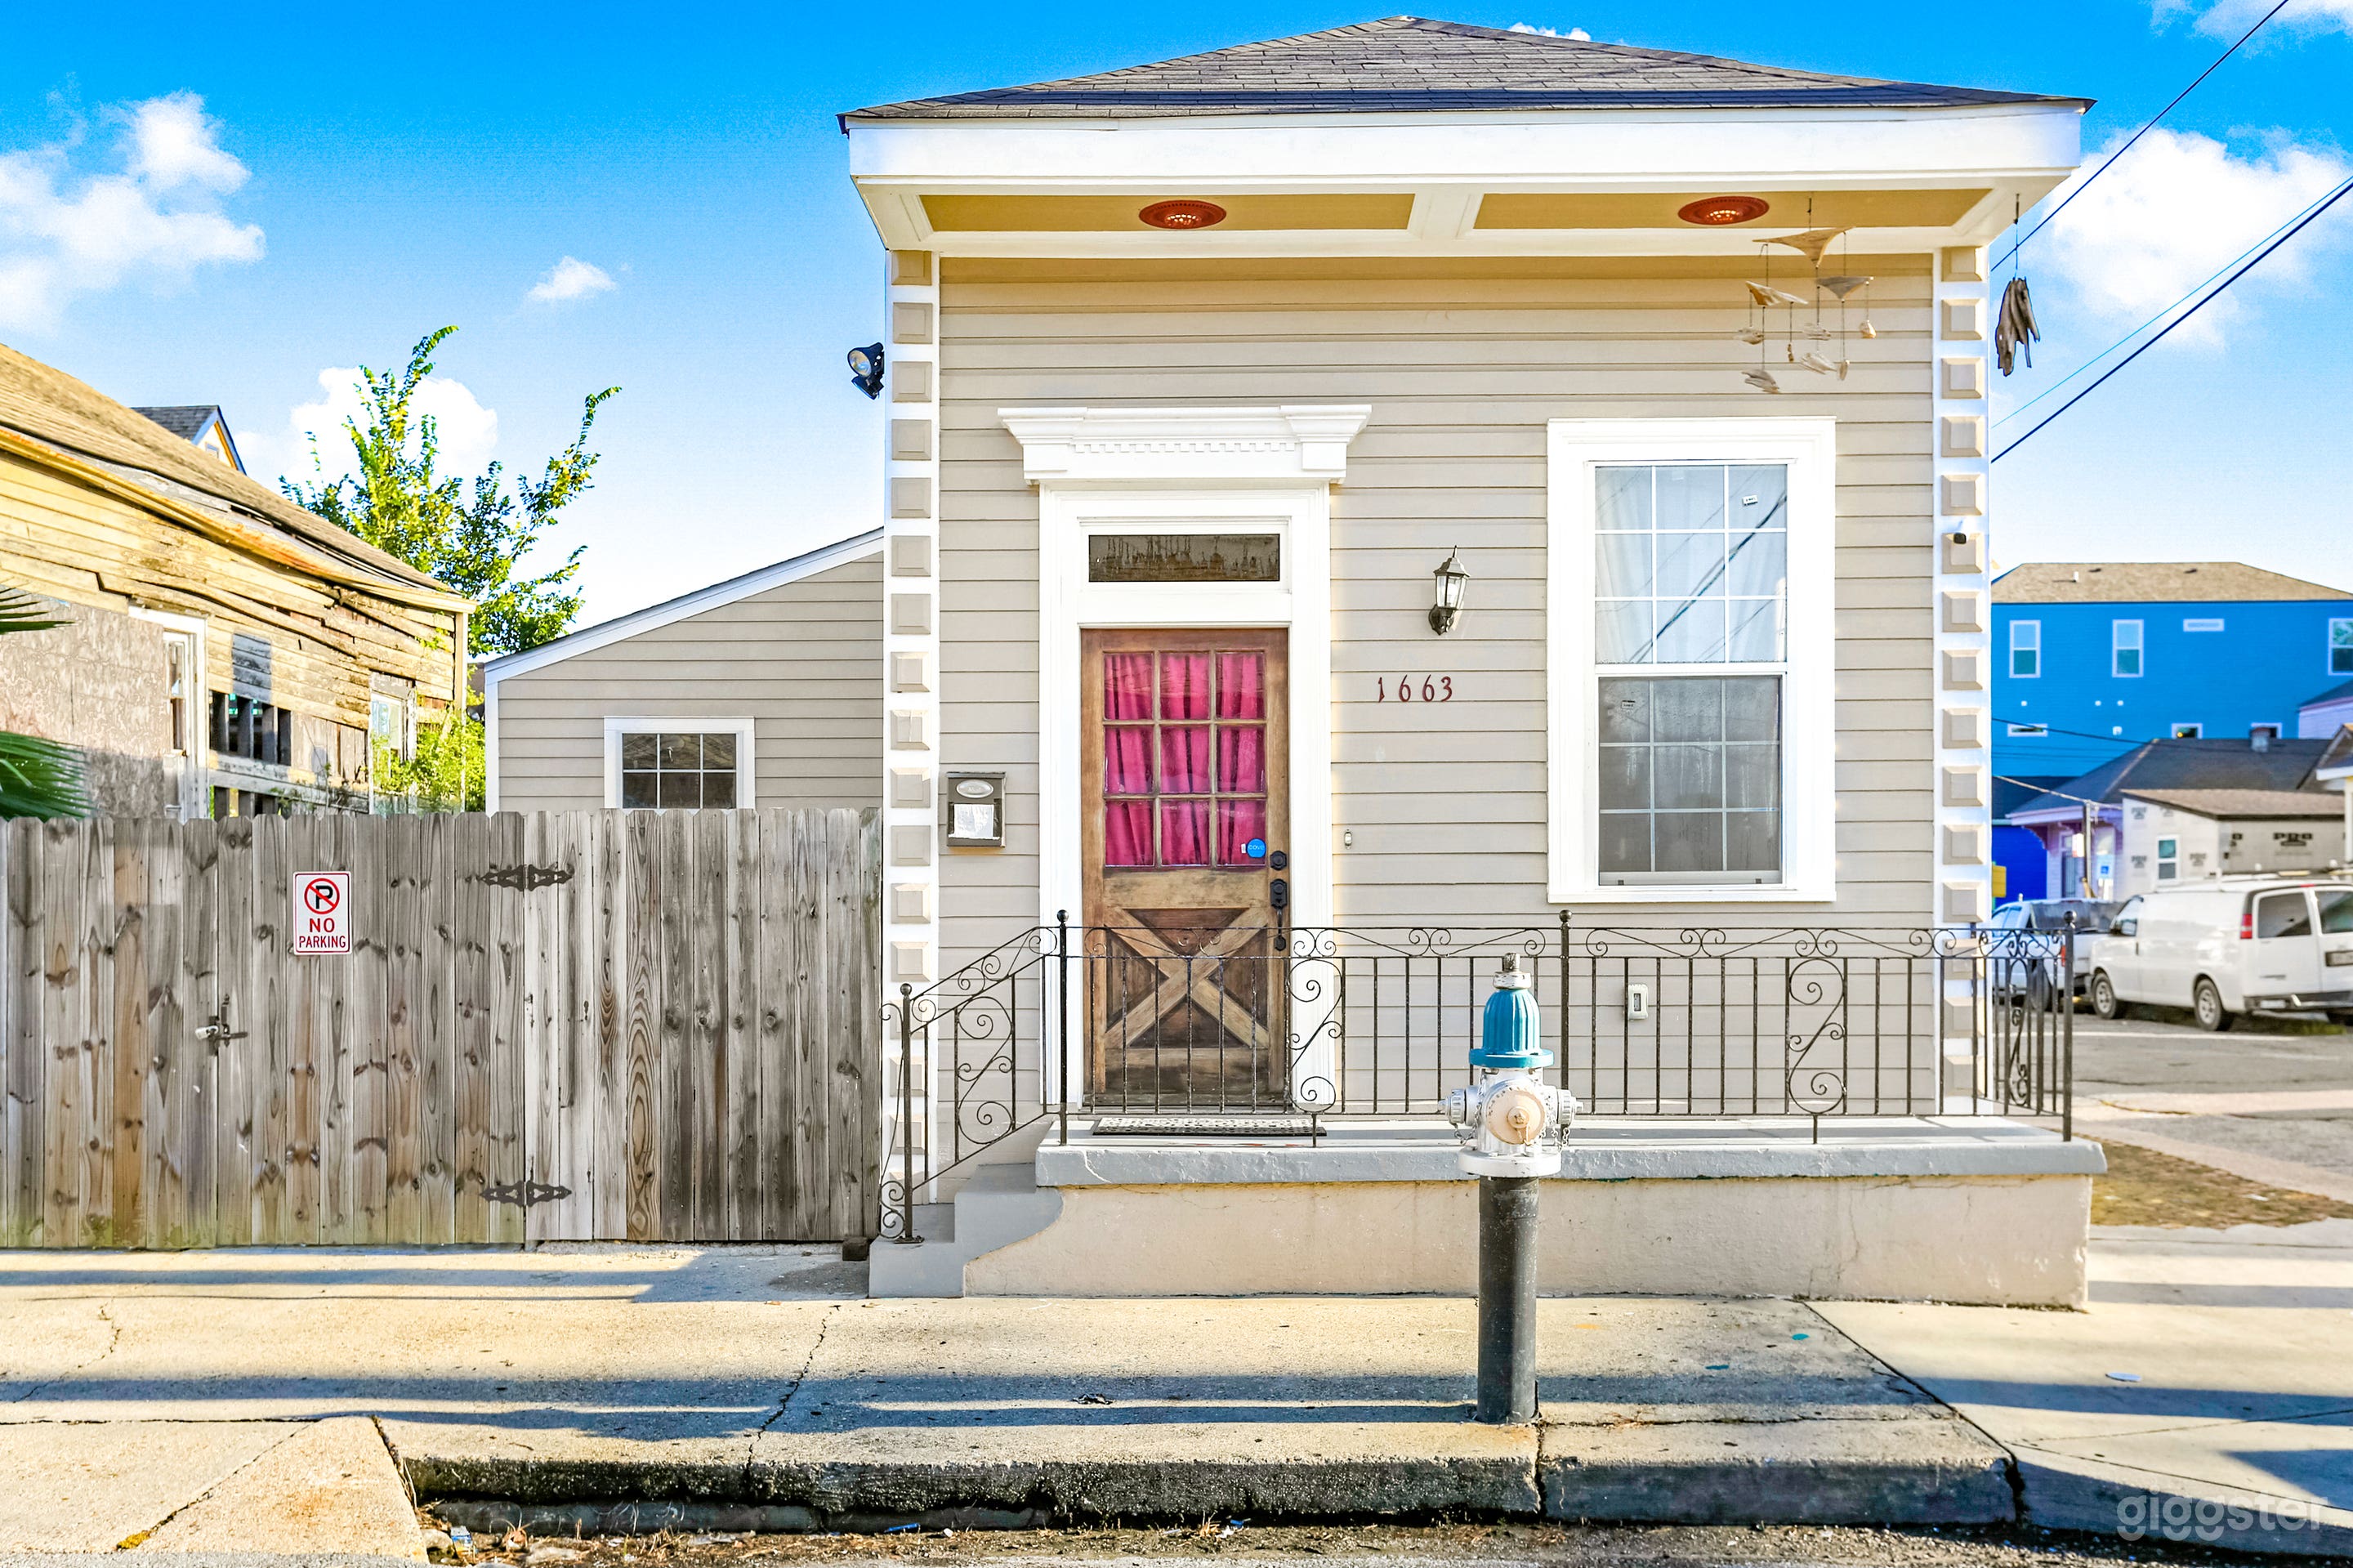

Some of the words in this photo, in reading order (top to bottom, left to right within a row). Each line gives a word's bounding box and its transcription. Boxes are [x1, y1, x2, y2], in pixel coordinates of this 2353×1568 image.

[1378, 674, 1453, 703] 1663
[310, 918, 335, 932] NO
[299, 936, 346, 948] PARKING
